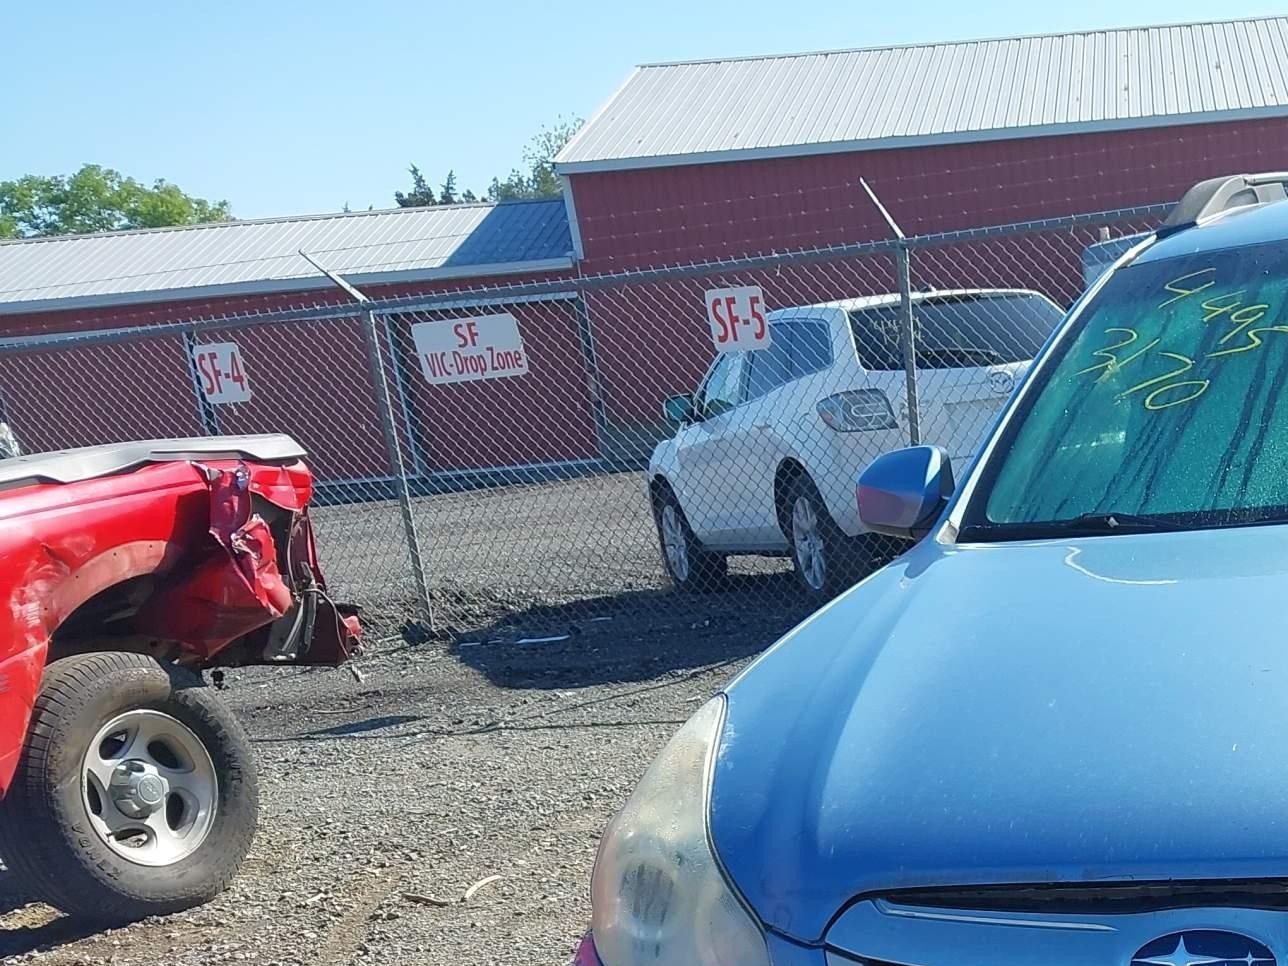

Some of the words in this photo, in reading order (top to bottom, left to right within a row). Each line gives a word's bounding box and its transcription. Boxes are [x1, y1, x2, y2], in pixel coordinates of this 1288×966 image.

[453, 322, 479, 348] SF
[711, 296, 766, 343] SF-5
[197, 351, 246, 396] SF-4
[424, 351, 488, 378] VIC-Drop
[486, 346, 524, 372] Zone
[1071, 327, 1211, 410] 3170
